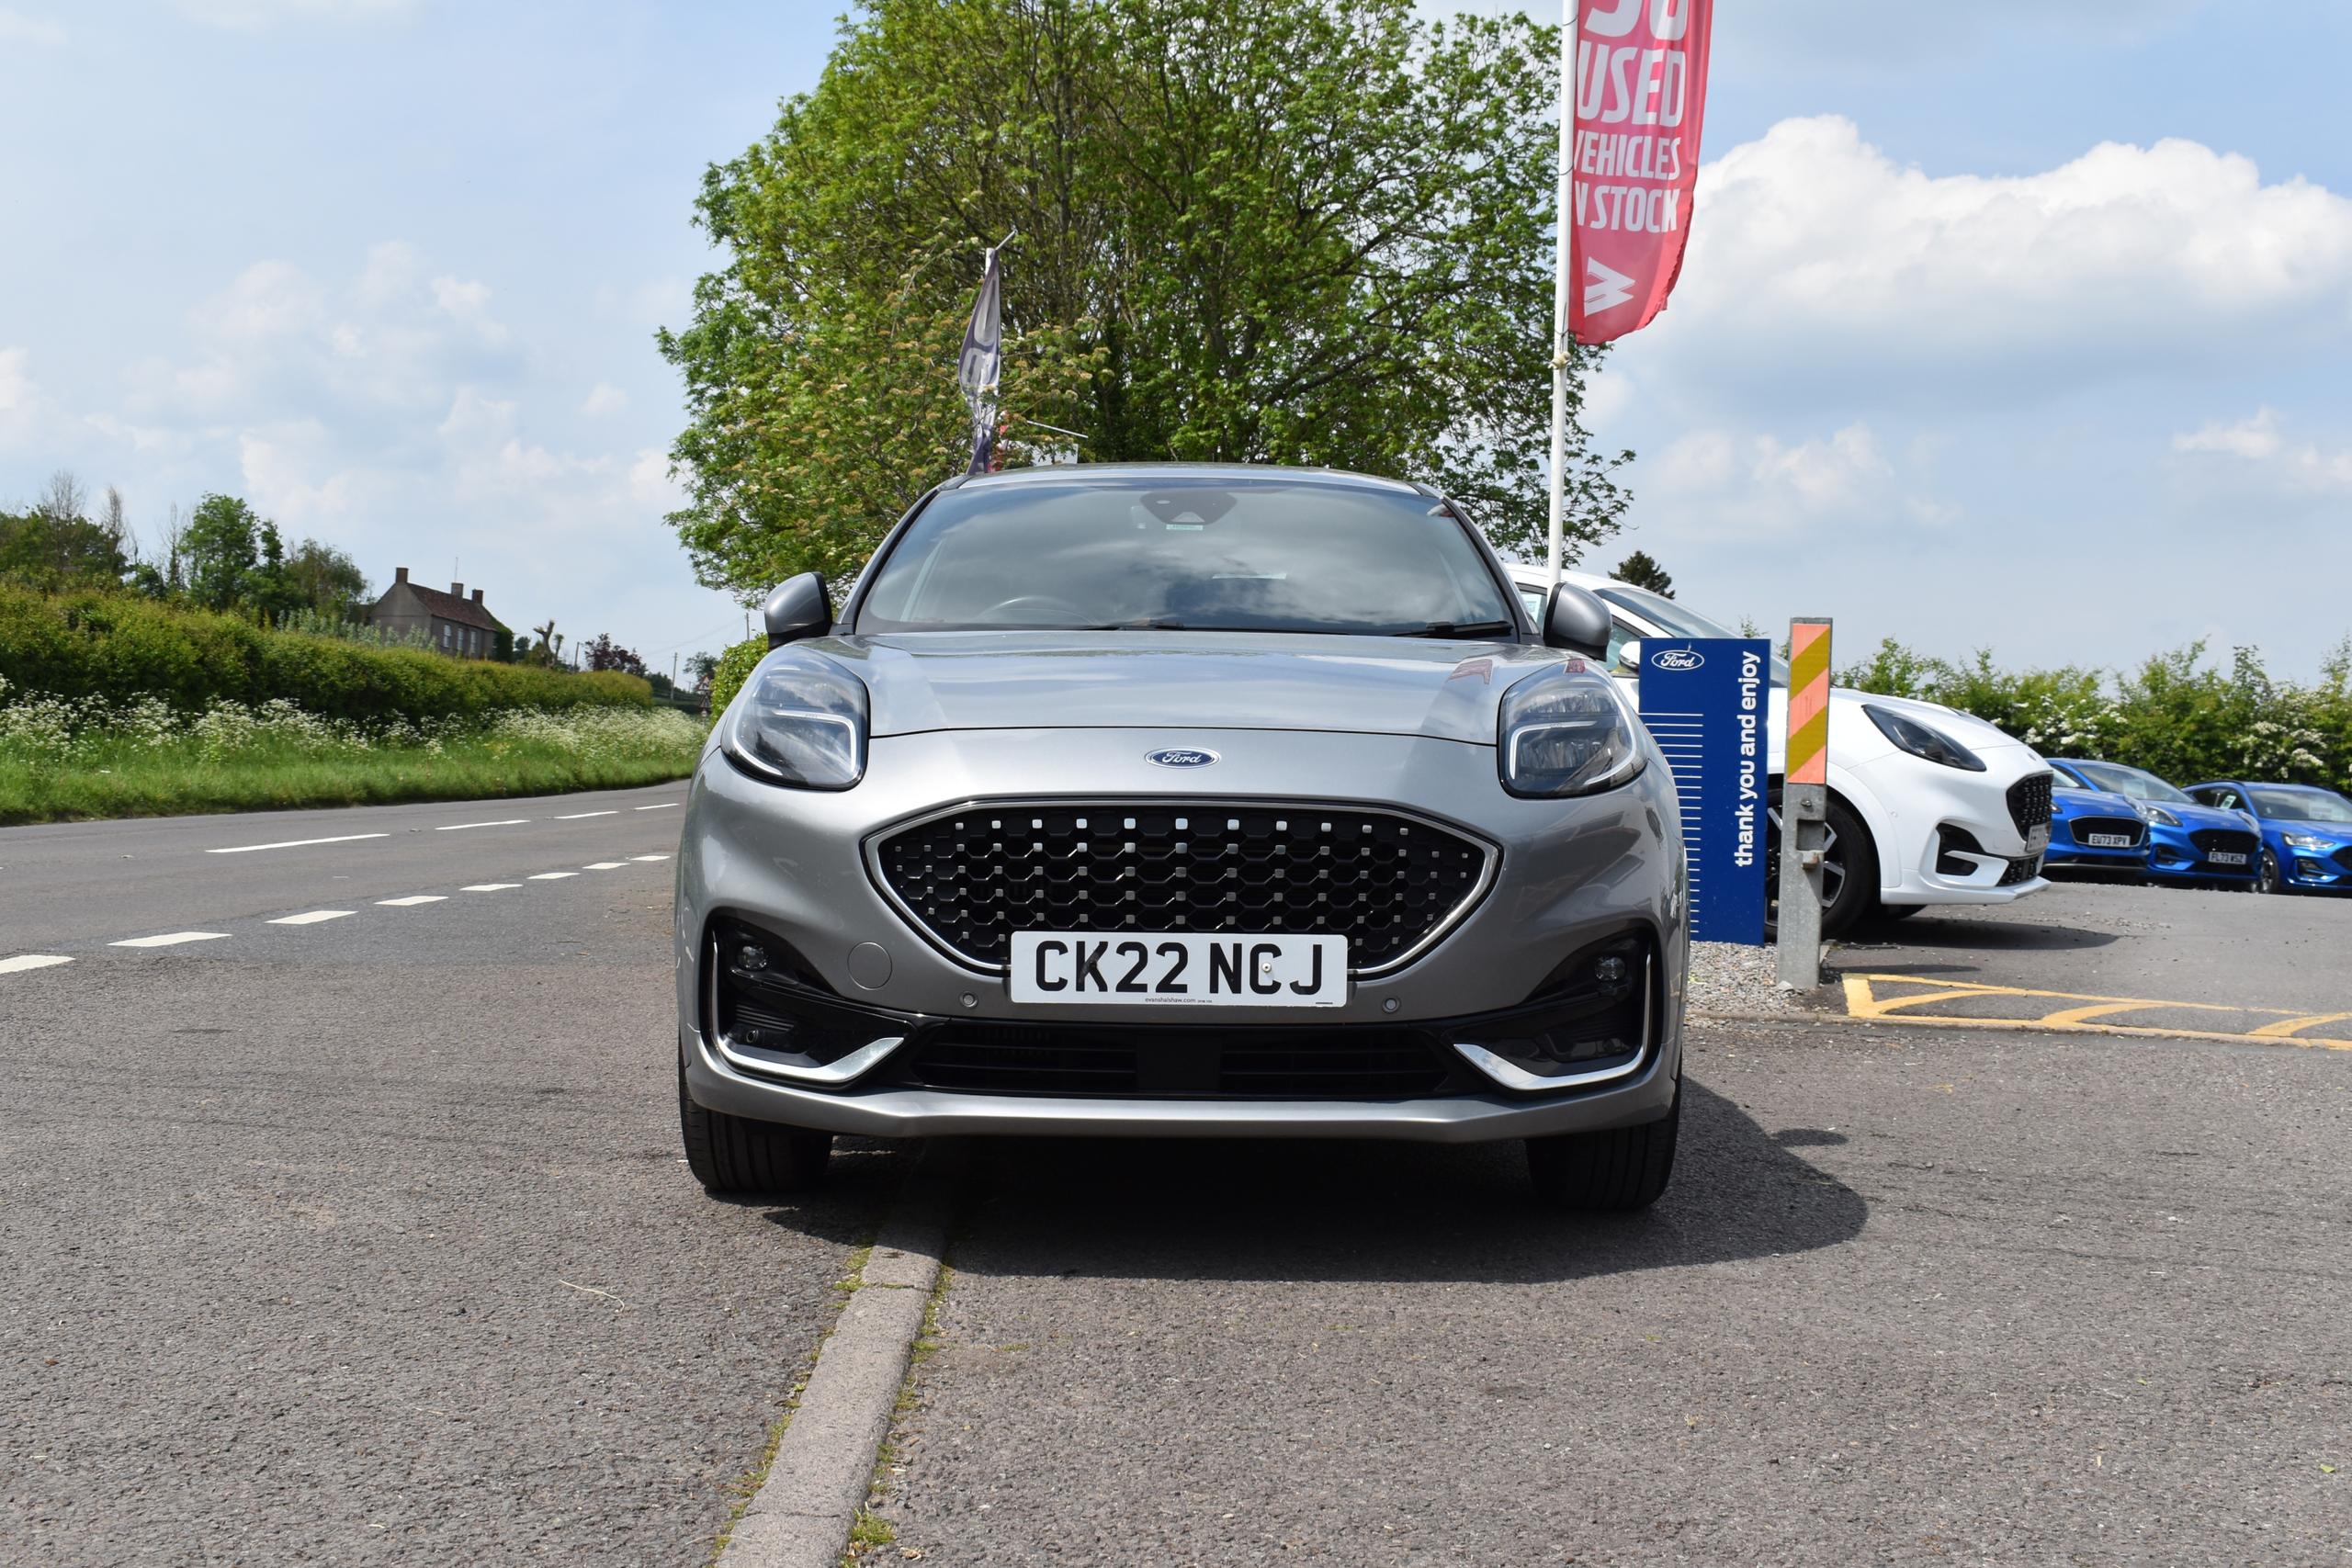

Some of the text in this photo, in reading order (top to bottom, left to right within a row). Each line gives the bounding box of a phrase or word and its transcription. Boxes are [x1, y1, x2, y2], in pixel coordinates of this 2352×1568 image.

[1577, 39, 1686, 127] USED
[1590, 186, 1680, 232] STOCK
[1660, 652, 1695, 667] Ford
[1161, 750, 1203, 763] Ford
[1734, 650, 1761, 867] thank you and enjoy
[1035, 940, 1323, 996] CK22 NCJ
